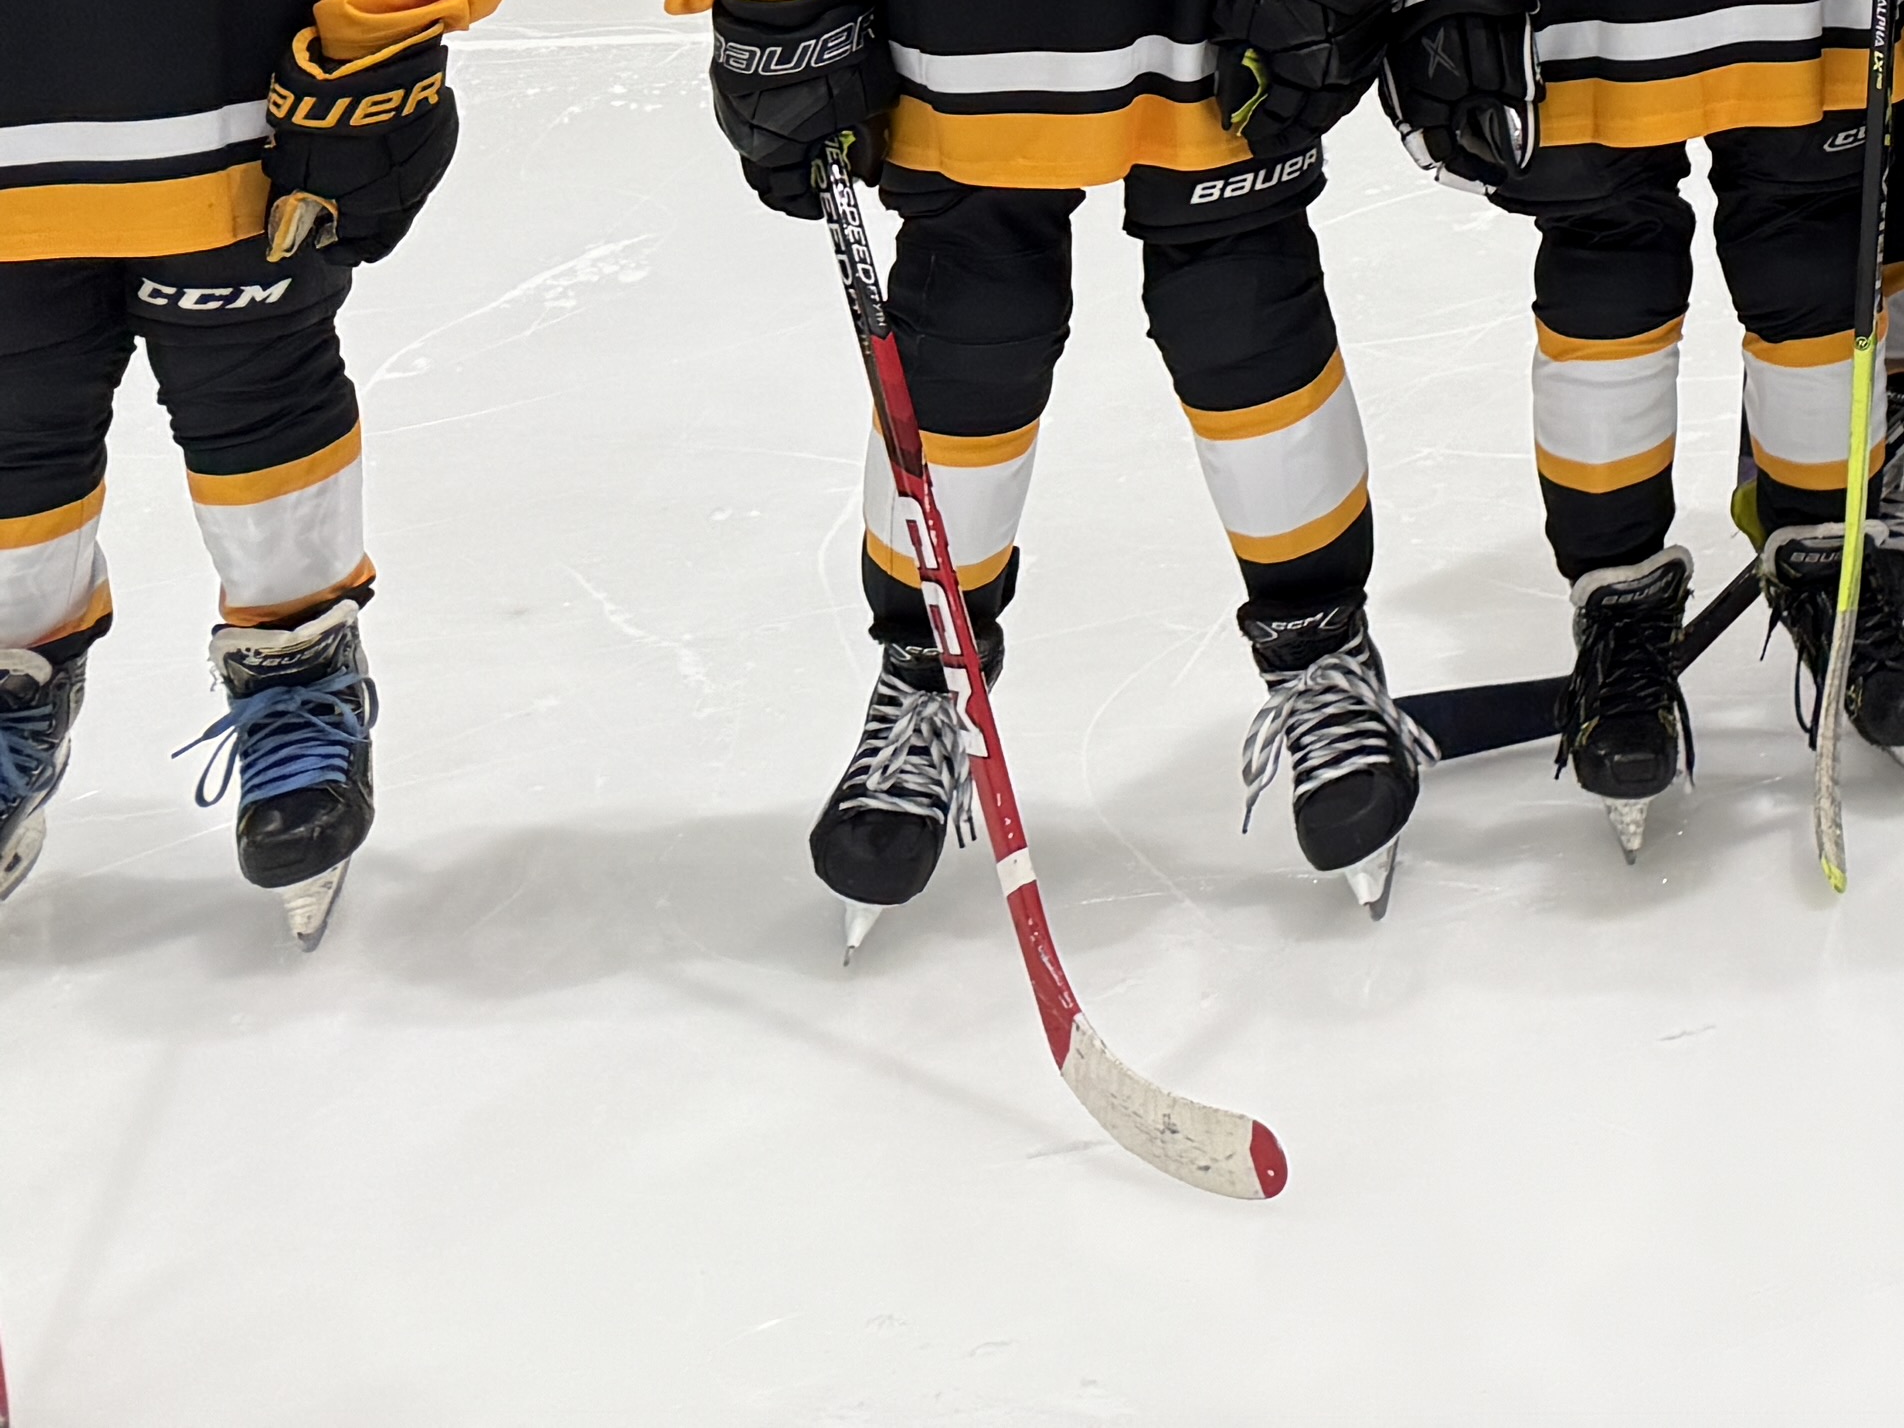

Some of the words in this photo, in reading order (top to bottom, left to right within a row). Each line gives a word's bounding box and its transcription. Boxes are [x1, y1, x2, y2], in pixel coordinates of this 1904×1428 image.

[267, 70, 445, 131] AUER
[1189, 146, 1318, 206] BAUER
[136, 276, 294, 313] CCM
[896, 494, 990, 758] CCM
